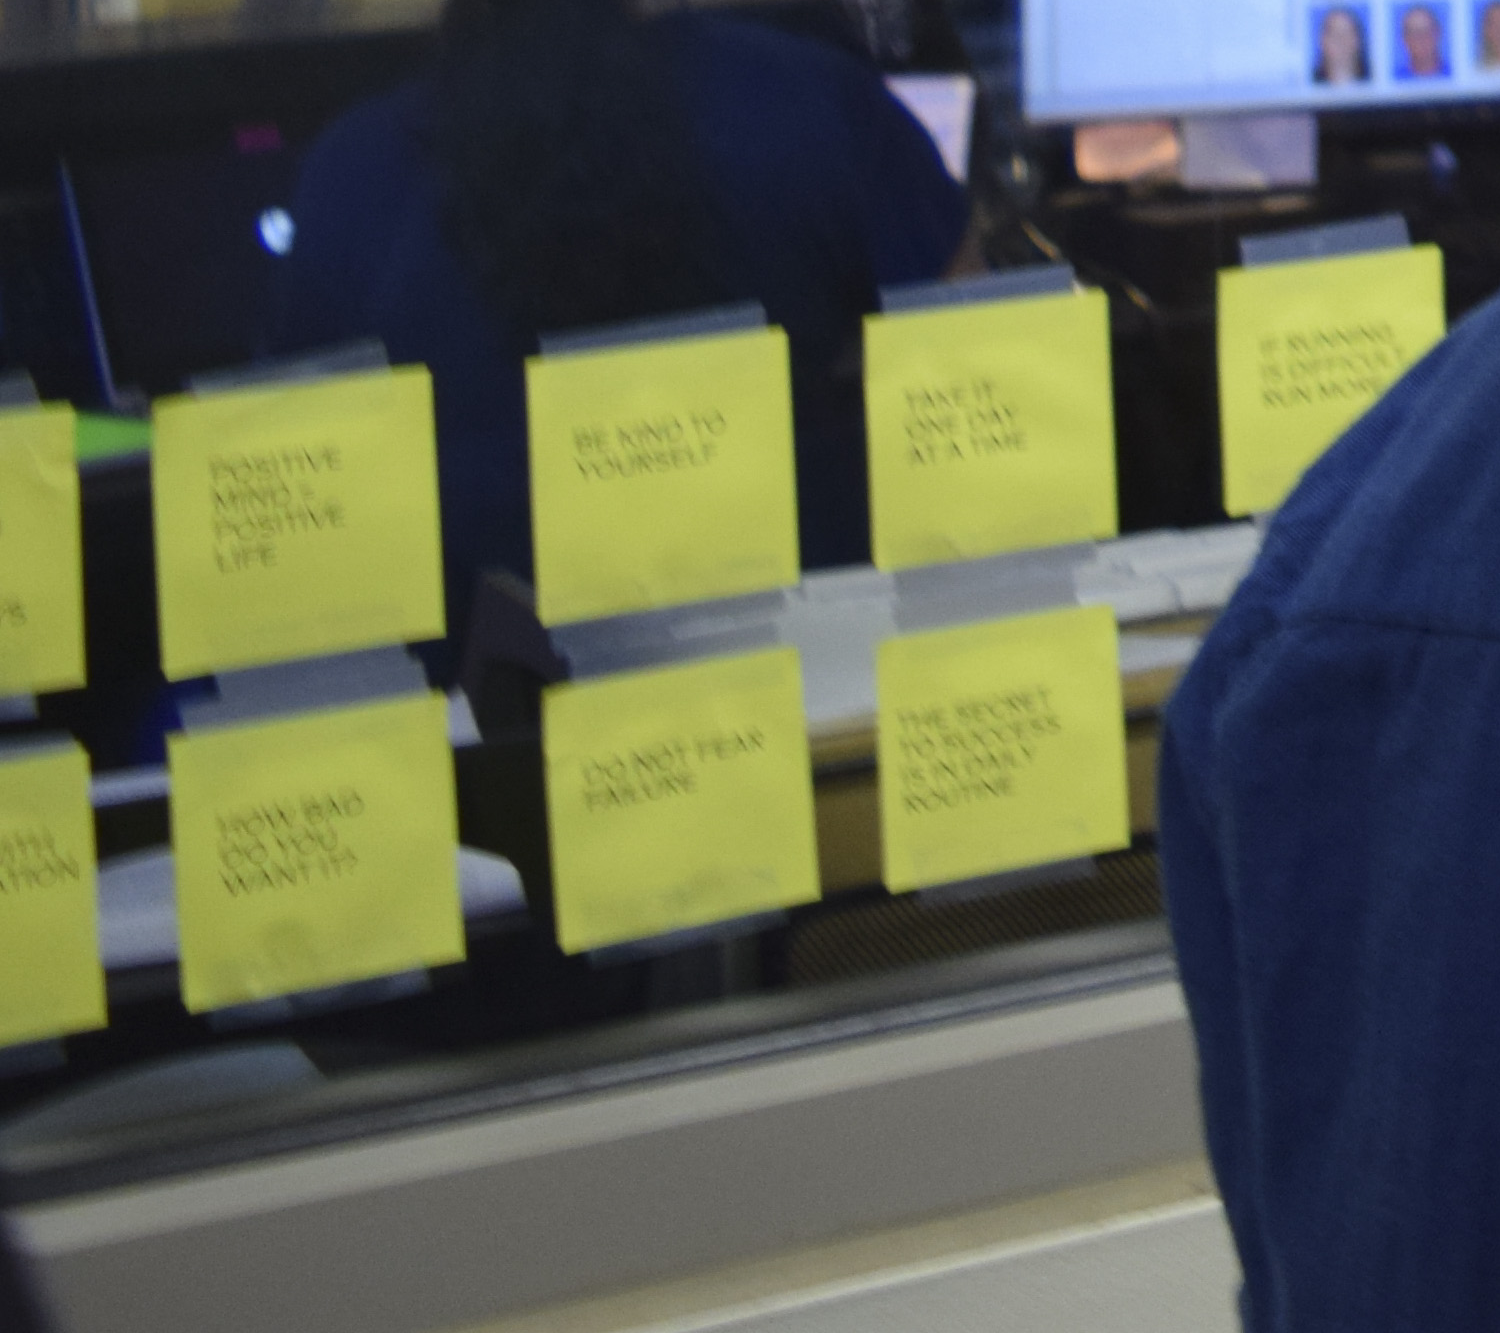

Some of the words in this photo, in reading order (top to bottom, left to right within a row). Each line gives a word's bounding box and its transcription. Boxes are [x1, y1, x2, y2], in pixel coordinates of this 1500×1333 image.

[903, 383, 966, 410] TAKE
[970, 377, 995, 401] IT
[572, 422, 610, 455] BE
[613, 412, 684, 449] KIND
[688, 406, 727, 440] TO
[903, 413, 960, 438] ONE
[968, 403, 1020, 427] DAY
[208, 442, 343, 482] POSITIVE
[572, 441, 718, 482] YOURSELF
[906, 441, 938, 467] AT
[943, 437, 966, 460] A
[970, 429, 1028, 455] TIME
[210, 481, 292, 513] MIND
[211, 496, 346, 542] POSITIVE
[211, 540, 279, 574] LIFE
[898, 707, 949, 730] THE
[955, 687, 1053, 722] SECRET
[581, 757, 627, 785] DO
[630, 742, 692, 778] NOT
[694, 724, 765, 762] FEAR
[901, 732, 936, 758] TO
[940, 713, 1063, 749] SUCCESS
[903, 763, 928, 786] IS
[934, 756, 962, 779] IN
[966, 743, 1038, 771] DAILY
[216, 799, 297, 838] HOW
[300, 785, 366, 826] BAD
[582, 771, 699, 813] FAILURE
[903, 774, 1017, 816] ROUTINE
[218, 838, 270, 870] DO
[274, 827, 340, 864] YOU
[220, 864, 312, 899] WANT
